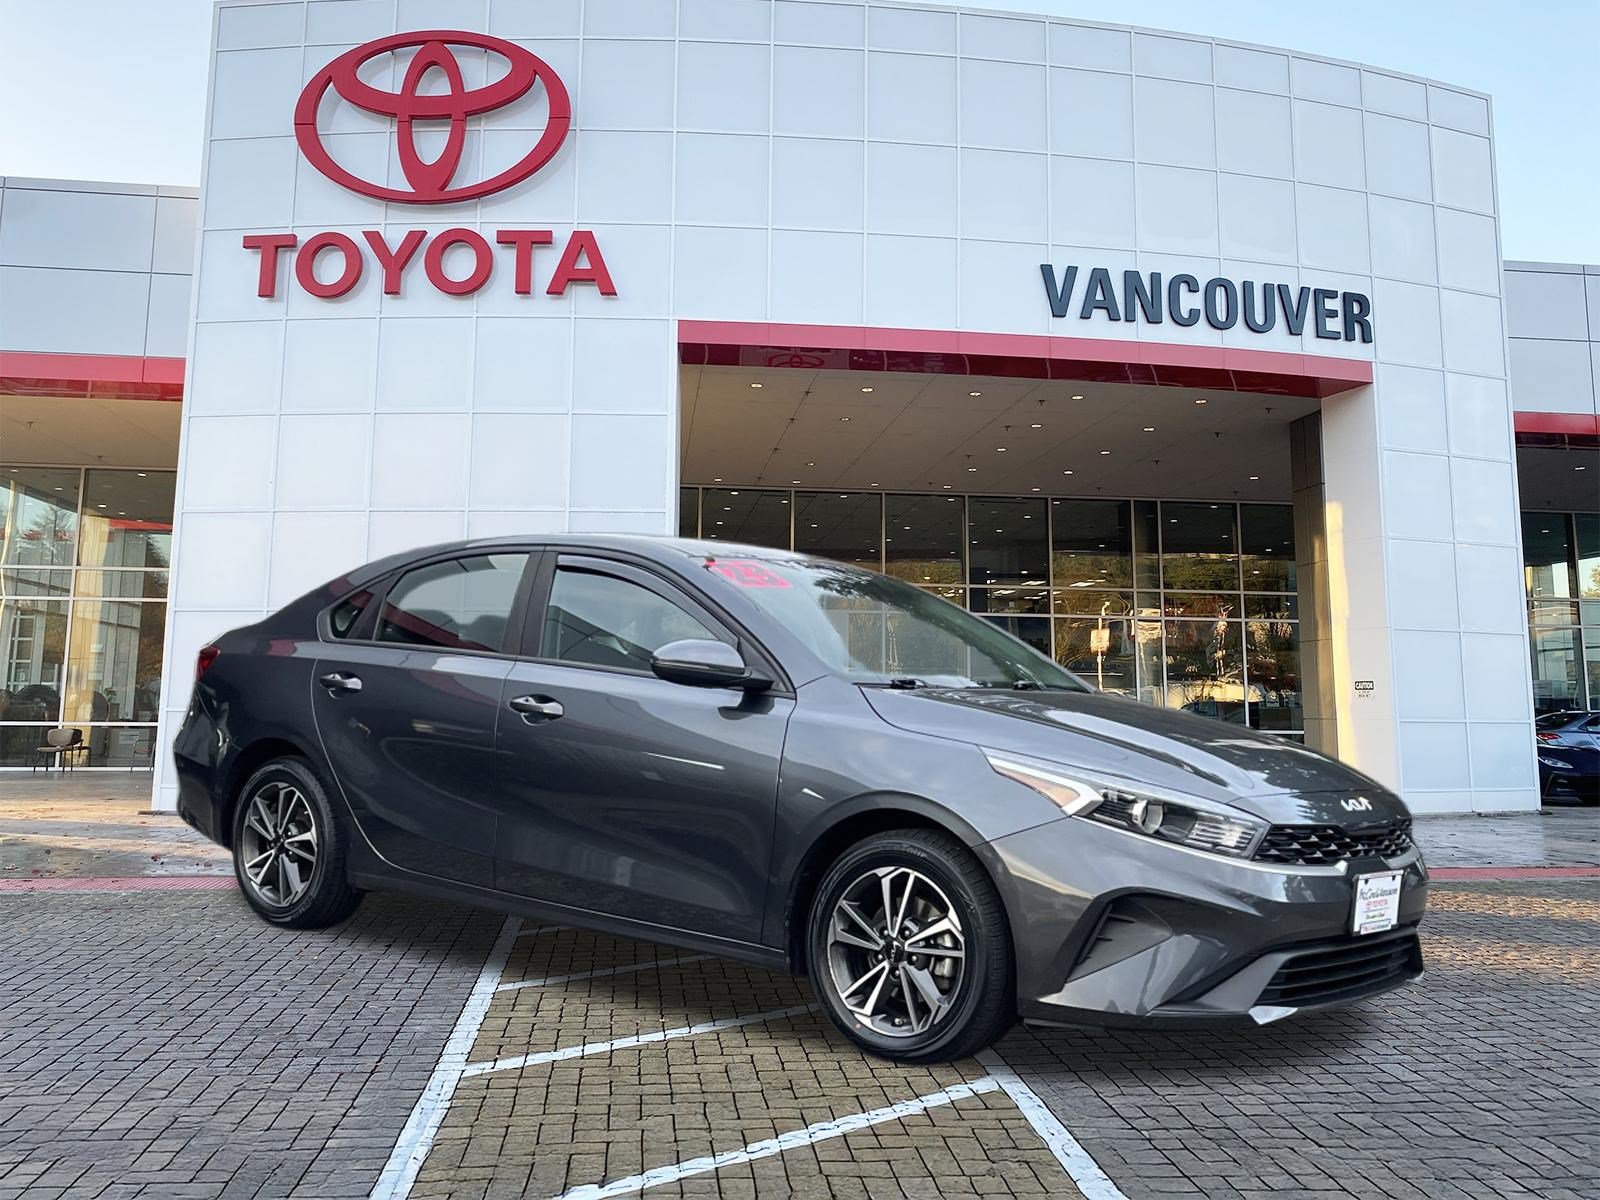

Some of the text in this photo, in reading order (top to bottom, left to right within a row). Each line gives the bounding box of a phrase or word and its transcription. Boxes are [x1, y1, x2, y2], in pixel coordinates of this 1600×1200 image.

[243, 227, 618, 299] TOYOTA
[1040, 264, 1373, 344] VANCOUVER
[1340, 797, 1373, 812] KIA
